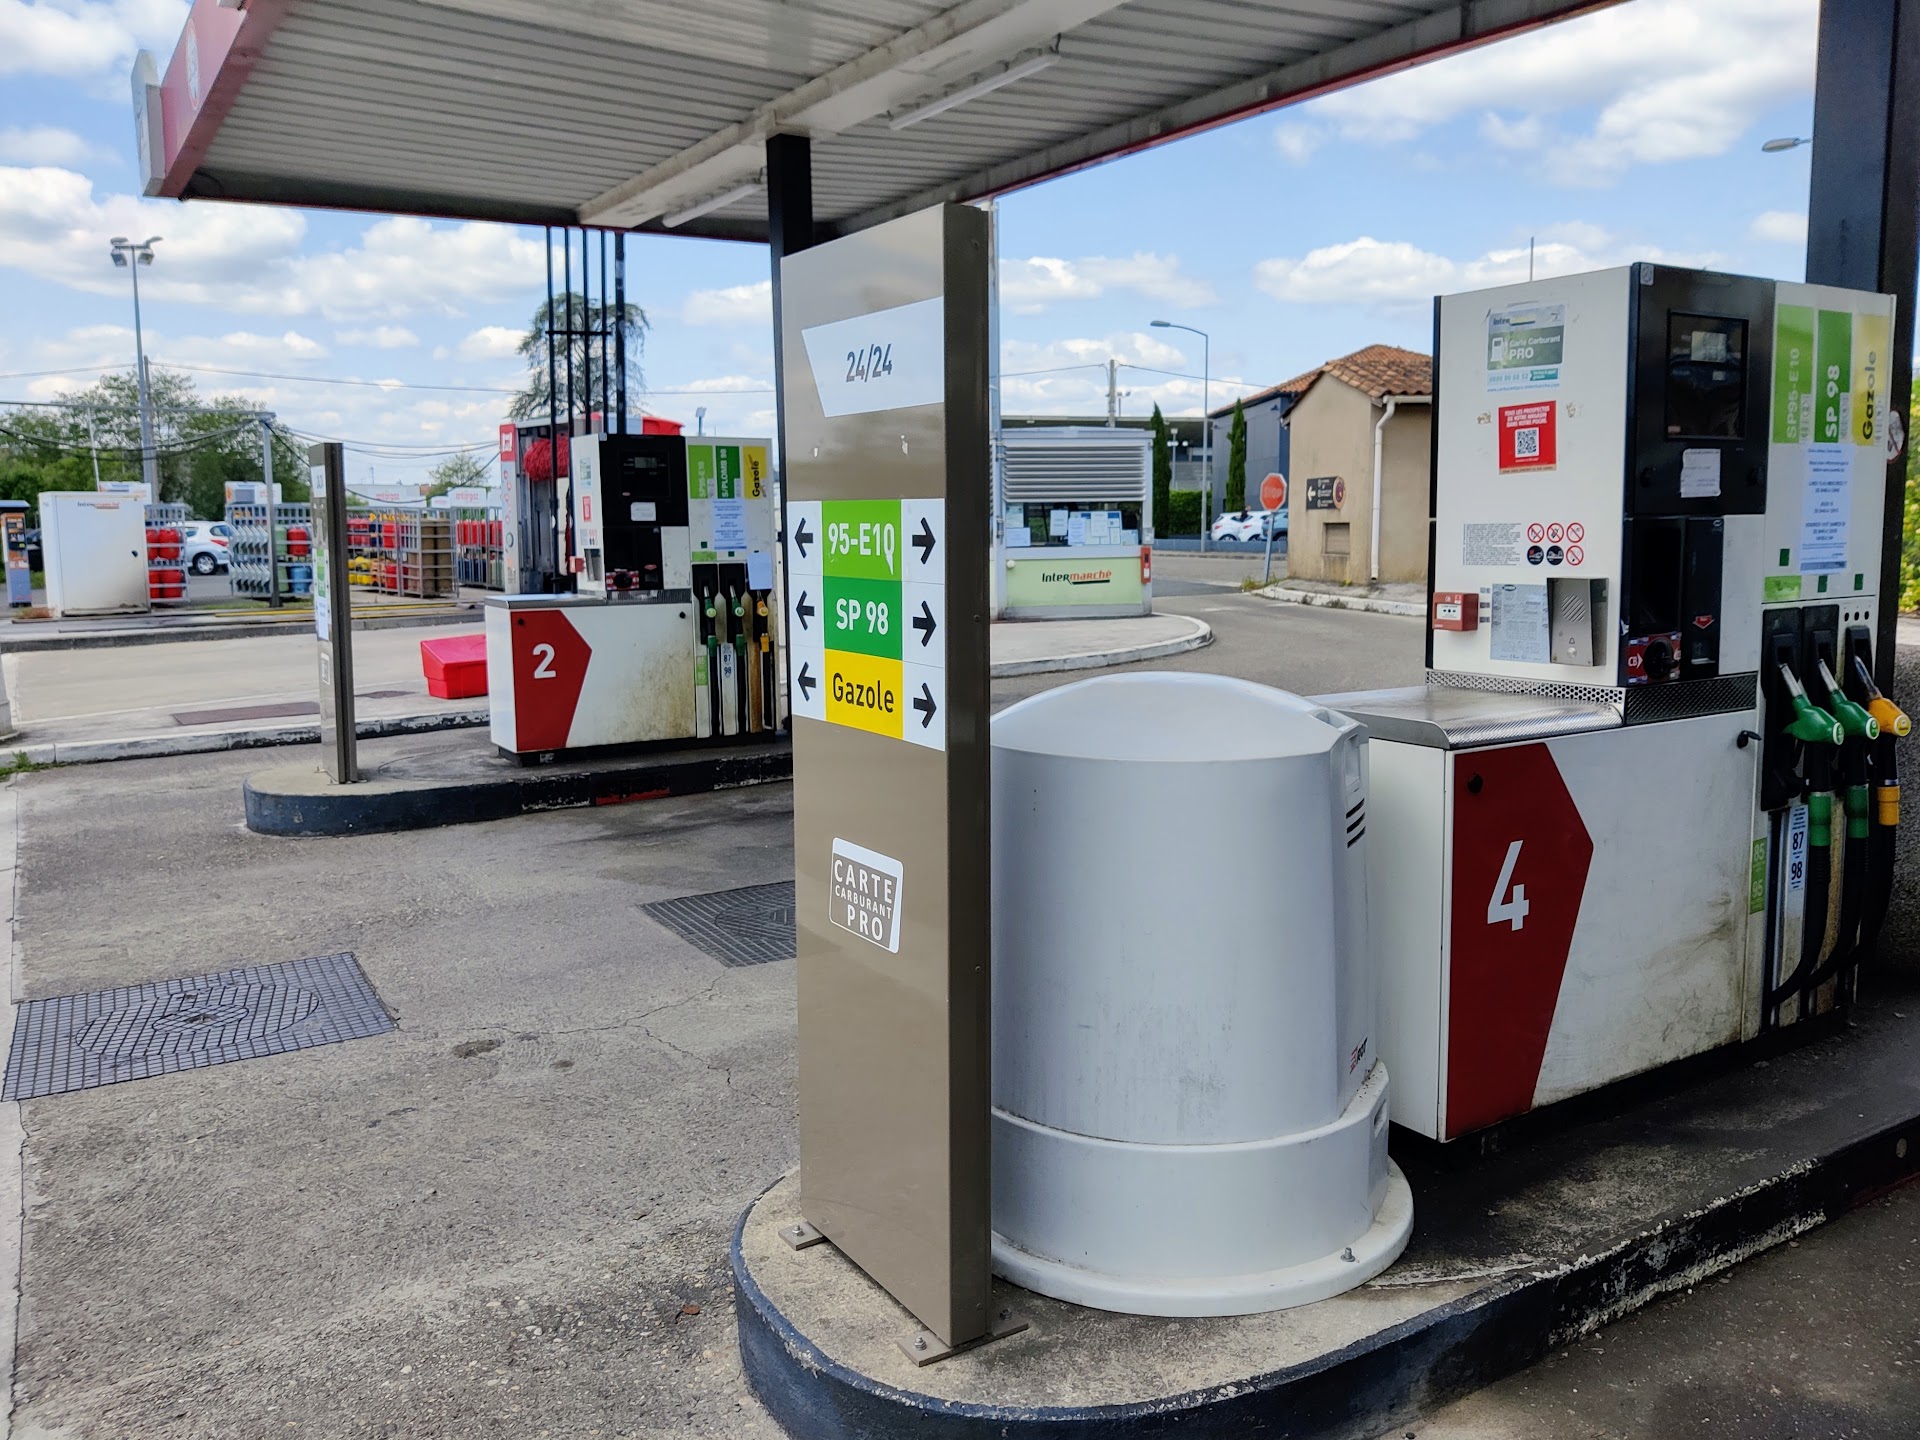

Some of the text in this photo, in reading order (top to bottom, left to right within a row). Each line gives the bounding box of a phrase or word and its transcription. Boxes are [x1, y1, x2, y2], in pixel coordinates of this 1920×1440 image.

[1510, 347, 1534, 360] PRO
[1528, 334, 1561, 345] Carburant
[846, 343, 892, 382] 24/24
[1786, 347, 1800, 439] SP95-E10
[1825, 364, 1840, 438] SP 98
[1862, 351, 1876, 439] Gazole
[751, 460, 760, 497] Gazole
[828, 522, 895, 558] 95-E10
[1042, 569, 1111, 584] Intermarché
[836, 598, 889, 635] SP 98
[532, 643, 557, 679] 2
[723, 654, 732, 662] 87
[832, 672, 895, 714] Gazole
[1792, 831, 1804, 850] 87
[833, 859, 893, 904] CARTE
[1487, 840, 1530, 931] 4
[1791, 861, 1803, 880] 98
[834, 884, 892, 920] CARBURANT
[847, 904, 884, 941] PRO
